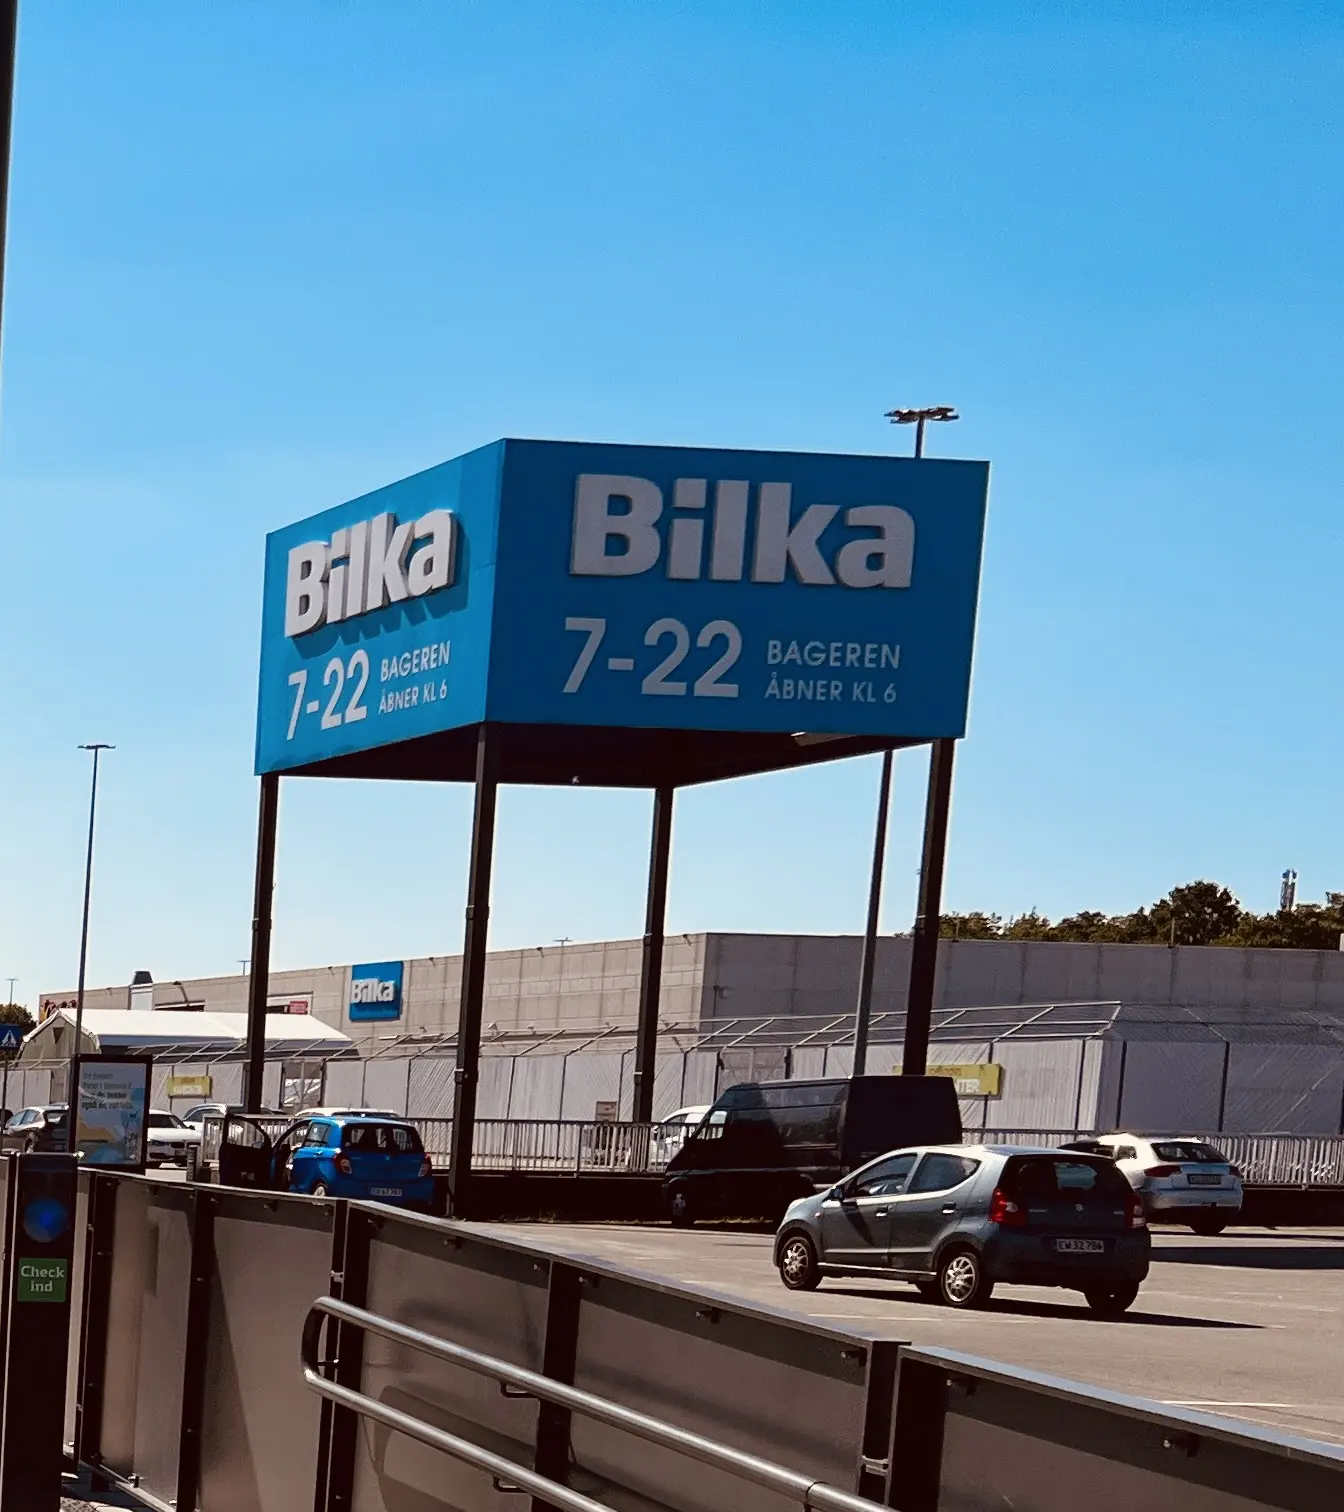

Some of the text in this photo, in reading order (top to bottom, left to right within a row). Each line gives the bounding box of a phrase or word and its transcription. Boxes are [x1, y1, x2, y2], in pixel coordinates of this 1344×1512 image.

[569, 473, 916, 589] Bilka
[285, 509, 457, 638] Bilka
[380, 640, 451, 683] BAGEREN
[562, 617, 743, 698] 7-22
[767, 640, 900, 669] BAGEREN
[287, 649, 370, 740] 7-22
[378, 679, 448, 715] ÅBNER KL 6
[764, 672, 897, 703] ÅBNER KL 6
[351, 978, 395, 1004] Bilka
[1073, 1241, 1085, 1250] 32
[20, 1265, 65, 1278] Check
[30, 1280, 53, 1292] ind
